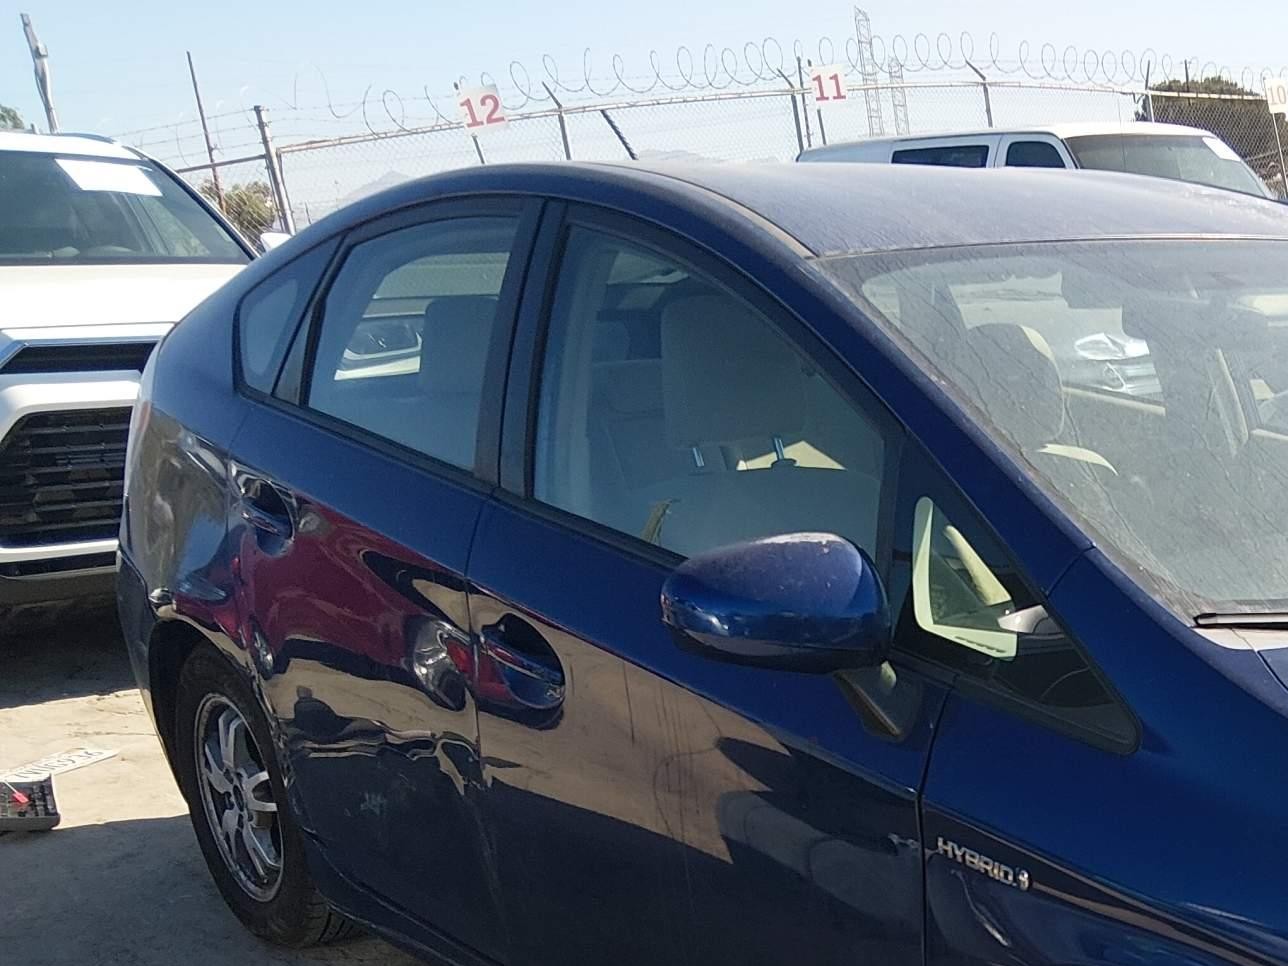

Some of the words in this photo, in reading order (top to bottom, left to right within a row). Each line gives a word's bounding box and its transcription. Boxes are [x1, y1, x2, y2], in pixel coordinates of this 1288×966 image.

[812, 73, 846, 101] 11
[1268, 85, 1287, 105] 10
[460, 94, 505, 128] 12
[938, 836, 1014, 886] HYBRID
